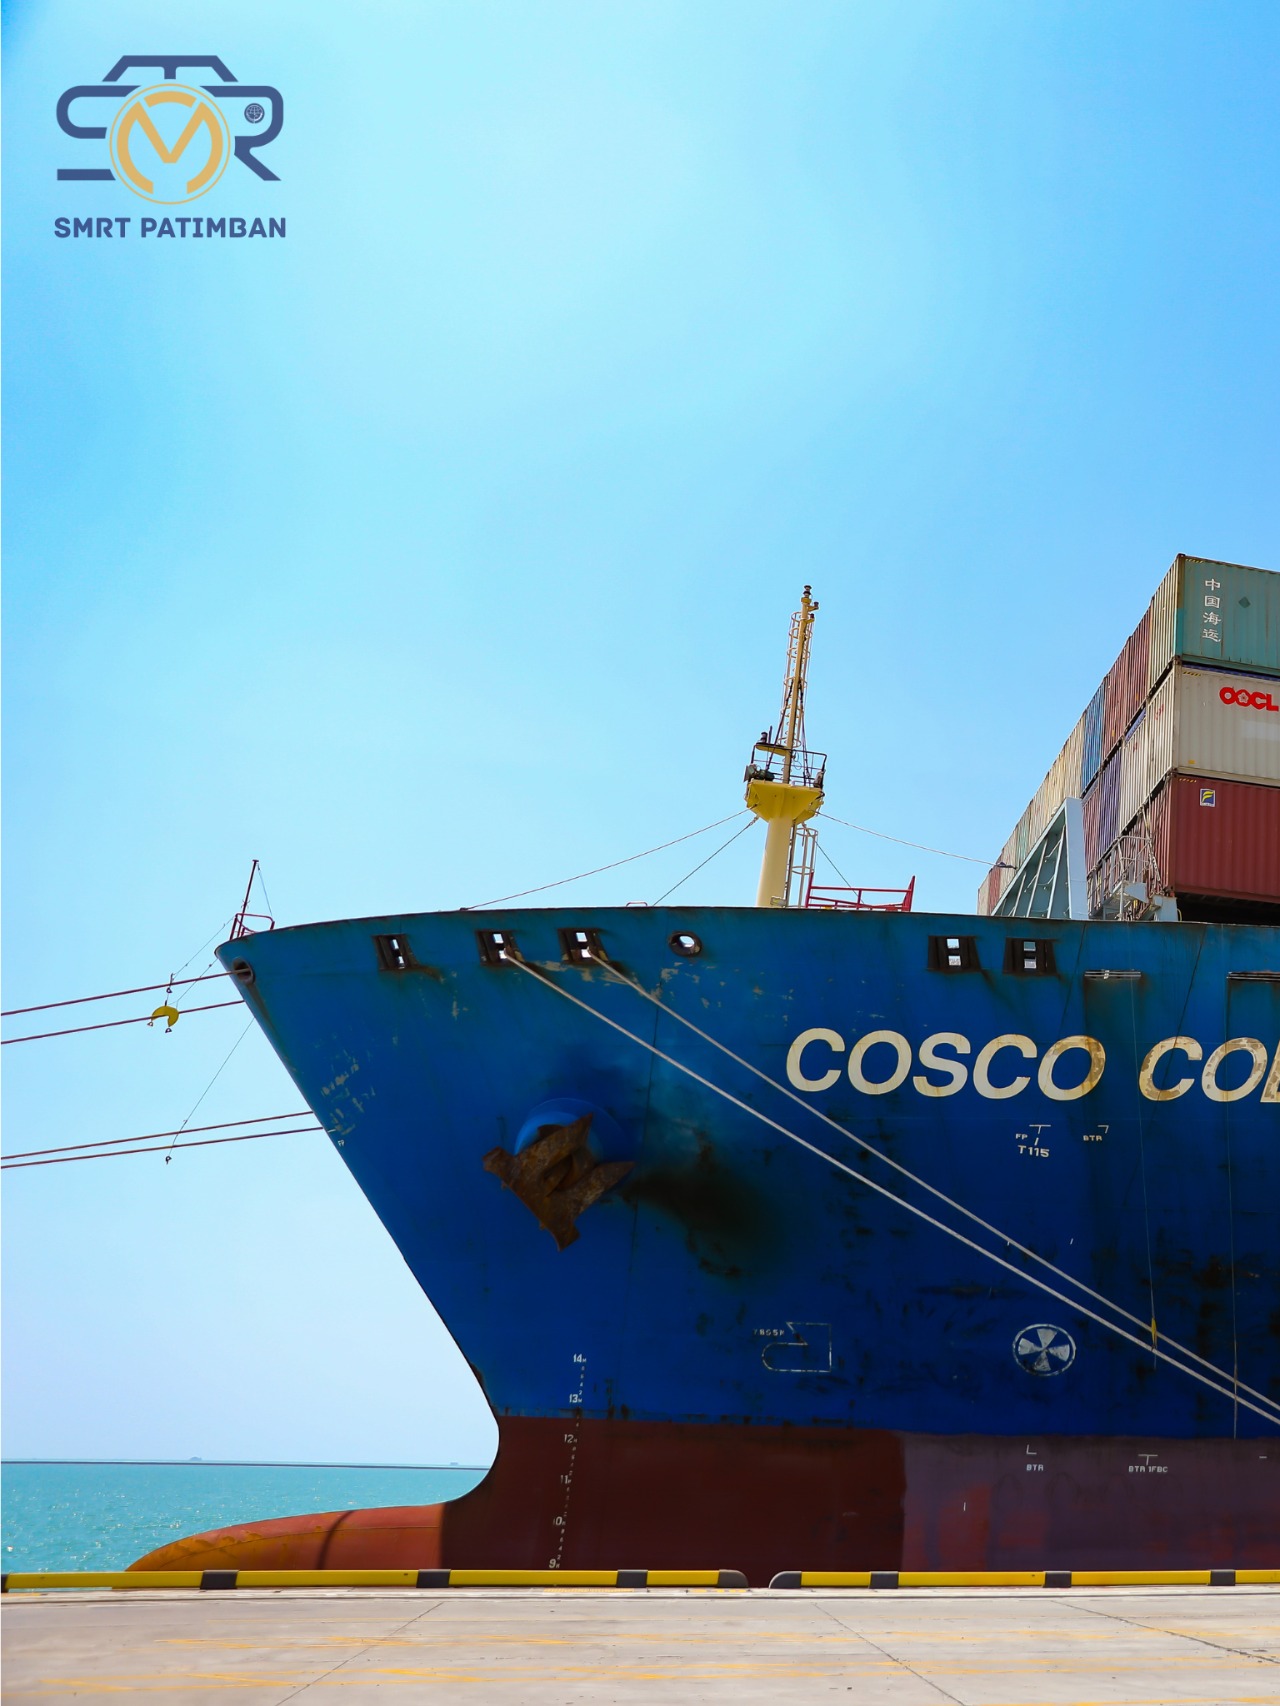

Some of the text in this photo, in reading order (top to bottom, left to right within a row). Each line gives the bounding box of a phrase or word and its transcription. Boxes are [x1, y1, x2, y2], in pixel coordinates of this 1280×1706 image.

[1202, 578, 1221, 642] 中国海运
[1219, 686, 1279, 712] OOCL
[785, 1027, 1106, 1101] COSCO
[1018, 1145, 1050, 1158] T115
[1128, 1465, 1146, 1473] BTR
